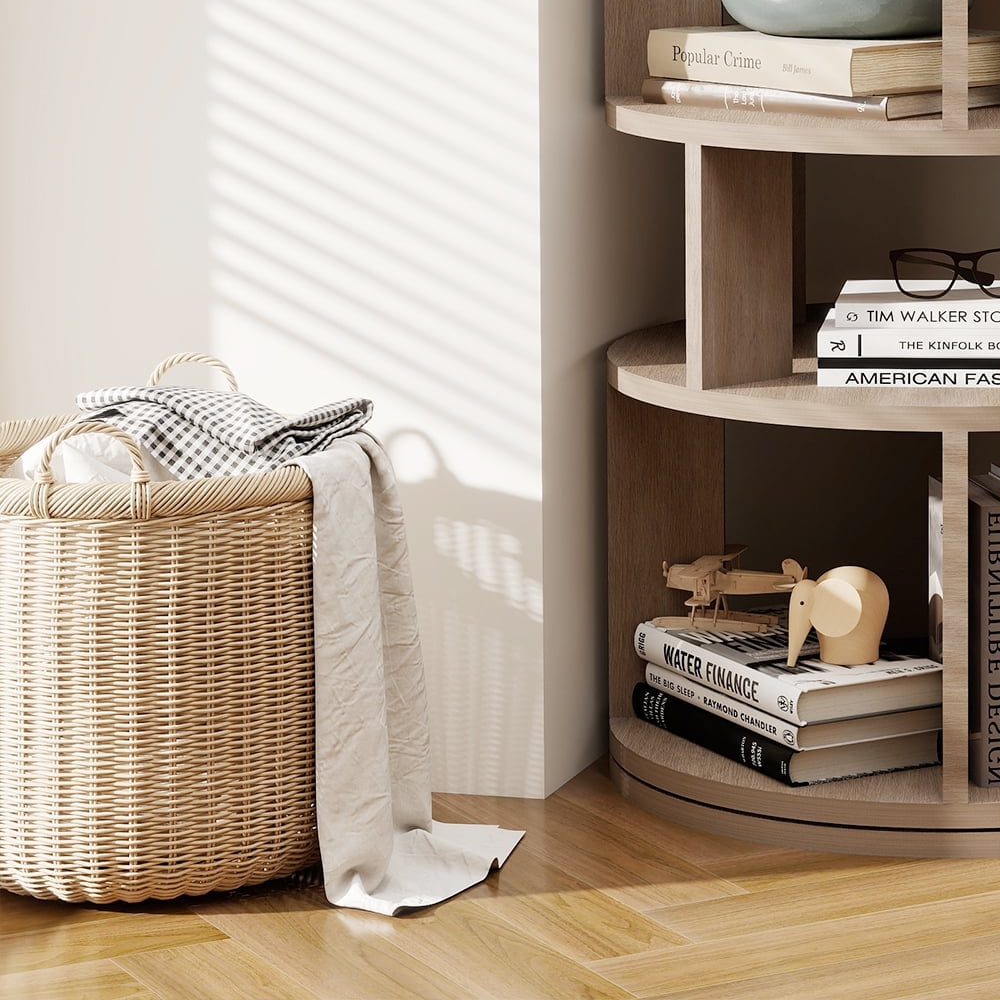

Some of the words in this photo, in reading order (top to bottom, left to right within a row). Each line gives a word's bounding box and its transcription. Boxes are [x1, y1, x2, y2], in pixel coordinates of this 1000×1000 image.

[672, 45, 720, 66] Popular
[723, 49, 762, 70] Crime
[867, 310, 894, 322] TIM
[900, 310, 967, 323] WALKER
[899, 341, 923, 350] THE
[928, 341, 982, 350] KINFOLK
[845, 372, 957, 385] AMERICAN
[663, 643, 703, 680] WATER
[706, 661, 760, 704] FINANCE
[649, 672, 661, 685] THE
[663, 679, 675, 691] BIG
[676, 685, 695, 700] SLEEP
[703, 696, 739, 719] RAYMOND
[740, 712, 778, 736] CHANDLER
